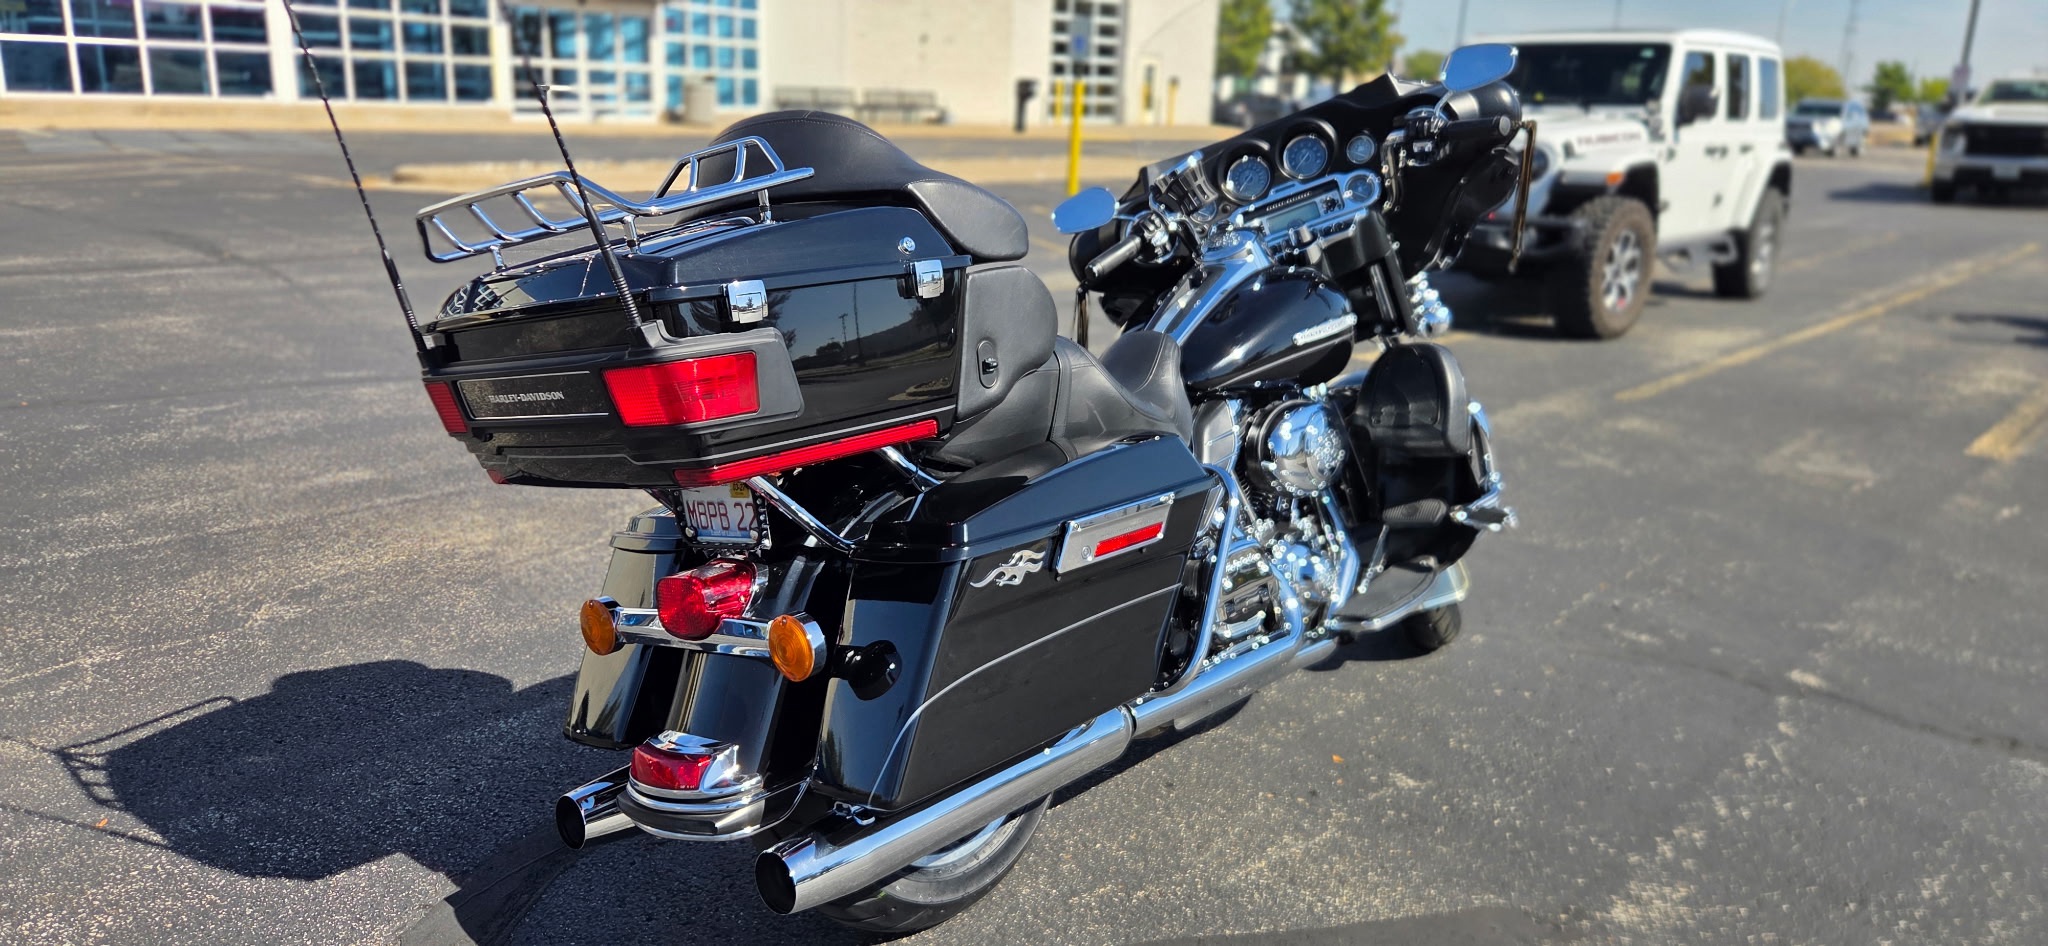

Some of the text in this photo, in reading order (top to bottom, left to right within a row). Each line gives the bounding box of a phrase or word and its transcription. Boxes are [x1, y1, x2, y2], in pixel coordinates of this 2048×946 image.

[488, 391, 565, 403] HARLEY-DAVIDSON
[686, 500, 757, 531] MBPB 22
